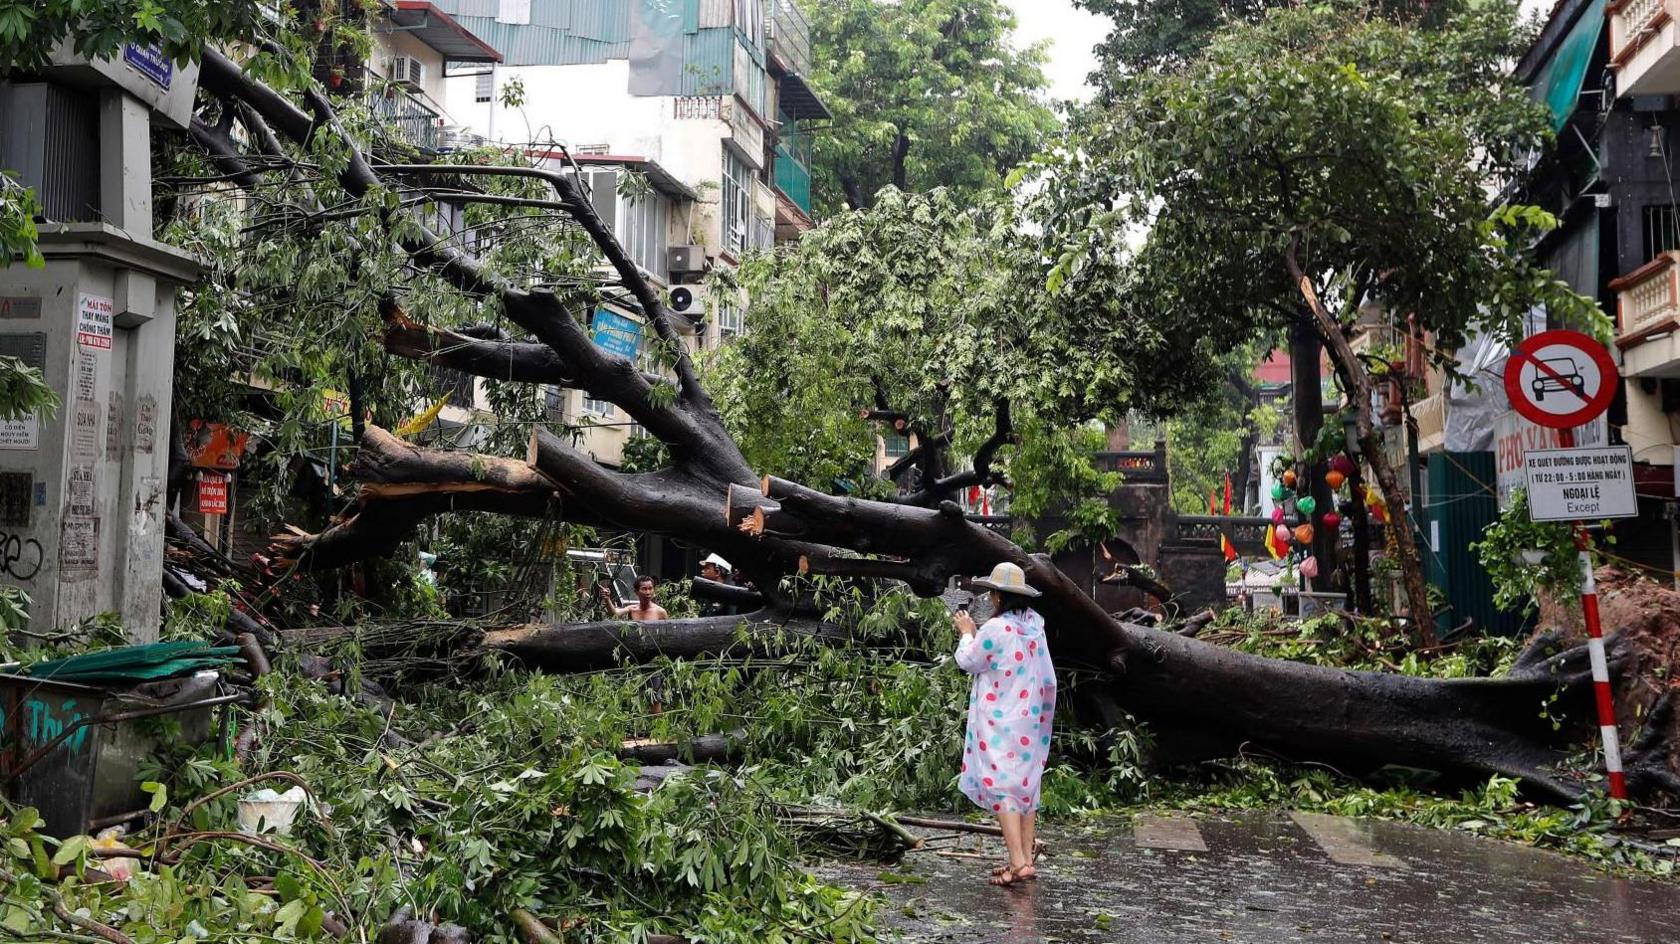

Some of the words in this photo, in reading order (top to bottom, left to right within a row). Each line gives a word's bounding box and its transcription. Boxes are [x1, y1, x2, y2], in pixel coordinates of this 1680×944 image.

[1528, 459, 1536, 468] XE
[1538, 456, 1552, 468] QUÉT
[1575, 455, 1591, 467] ĐƯỢC
[1593, 455, 1608, 466] HOẠT
[1609, 453, 1626, 465] ĐỘNG
[1587, 469, 1604, 480] HÀNG
[1605, 469, 1621, 480] NGÀY
[1562, 487, 1589, 501] NGOẠI
[1590, 485, 1600, 501] LỆ
[1567, 502, 1600, 514] Except
